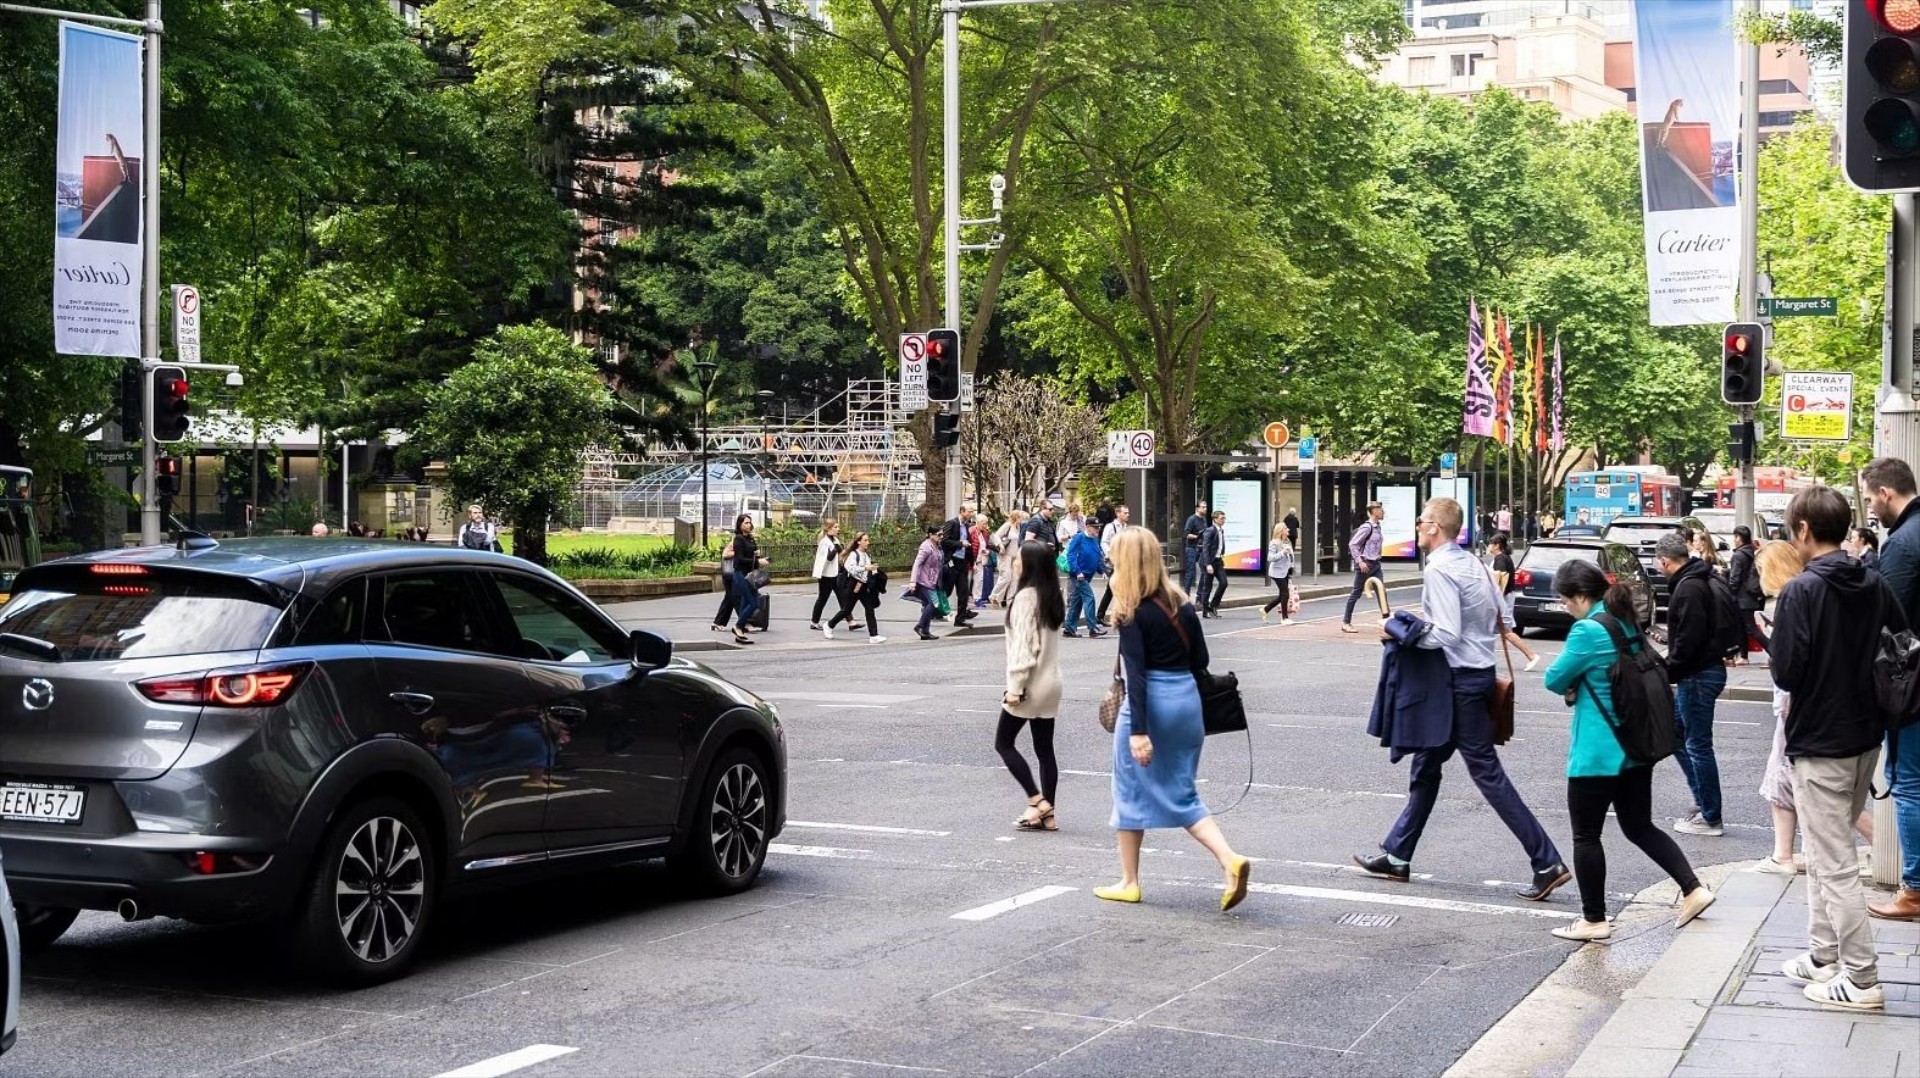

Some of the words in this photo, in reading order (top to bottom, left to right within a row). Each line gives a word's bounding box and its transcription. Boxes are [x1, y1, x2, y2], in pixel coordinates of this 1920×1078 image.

[1658, 229, 1731, 254] Cartier
[1775, 299, 1818, 311] Margaret
[1820, 299, 1831, 308] St
[183, 316, 194, 326] NO
[906, 364, 921, 373] NO
[1791, 375, 1844, 384] CLEARWAY
[1787, 384, 1816, 392] SPECIAL
[1271, 428, 1283, 443] T
[1134, 438, 1151, 450] 40
[96, 452, 125, 463] Margaret
[1132, 458, 1153, 466] AREA
